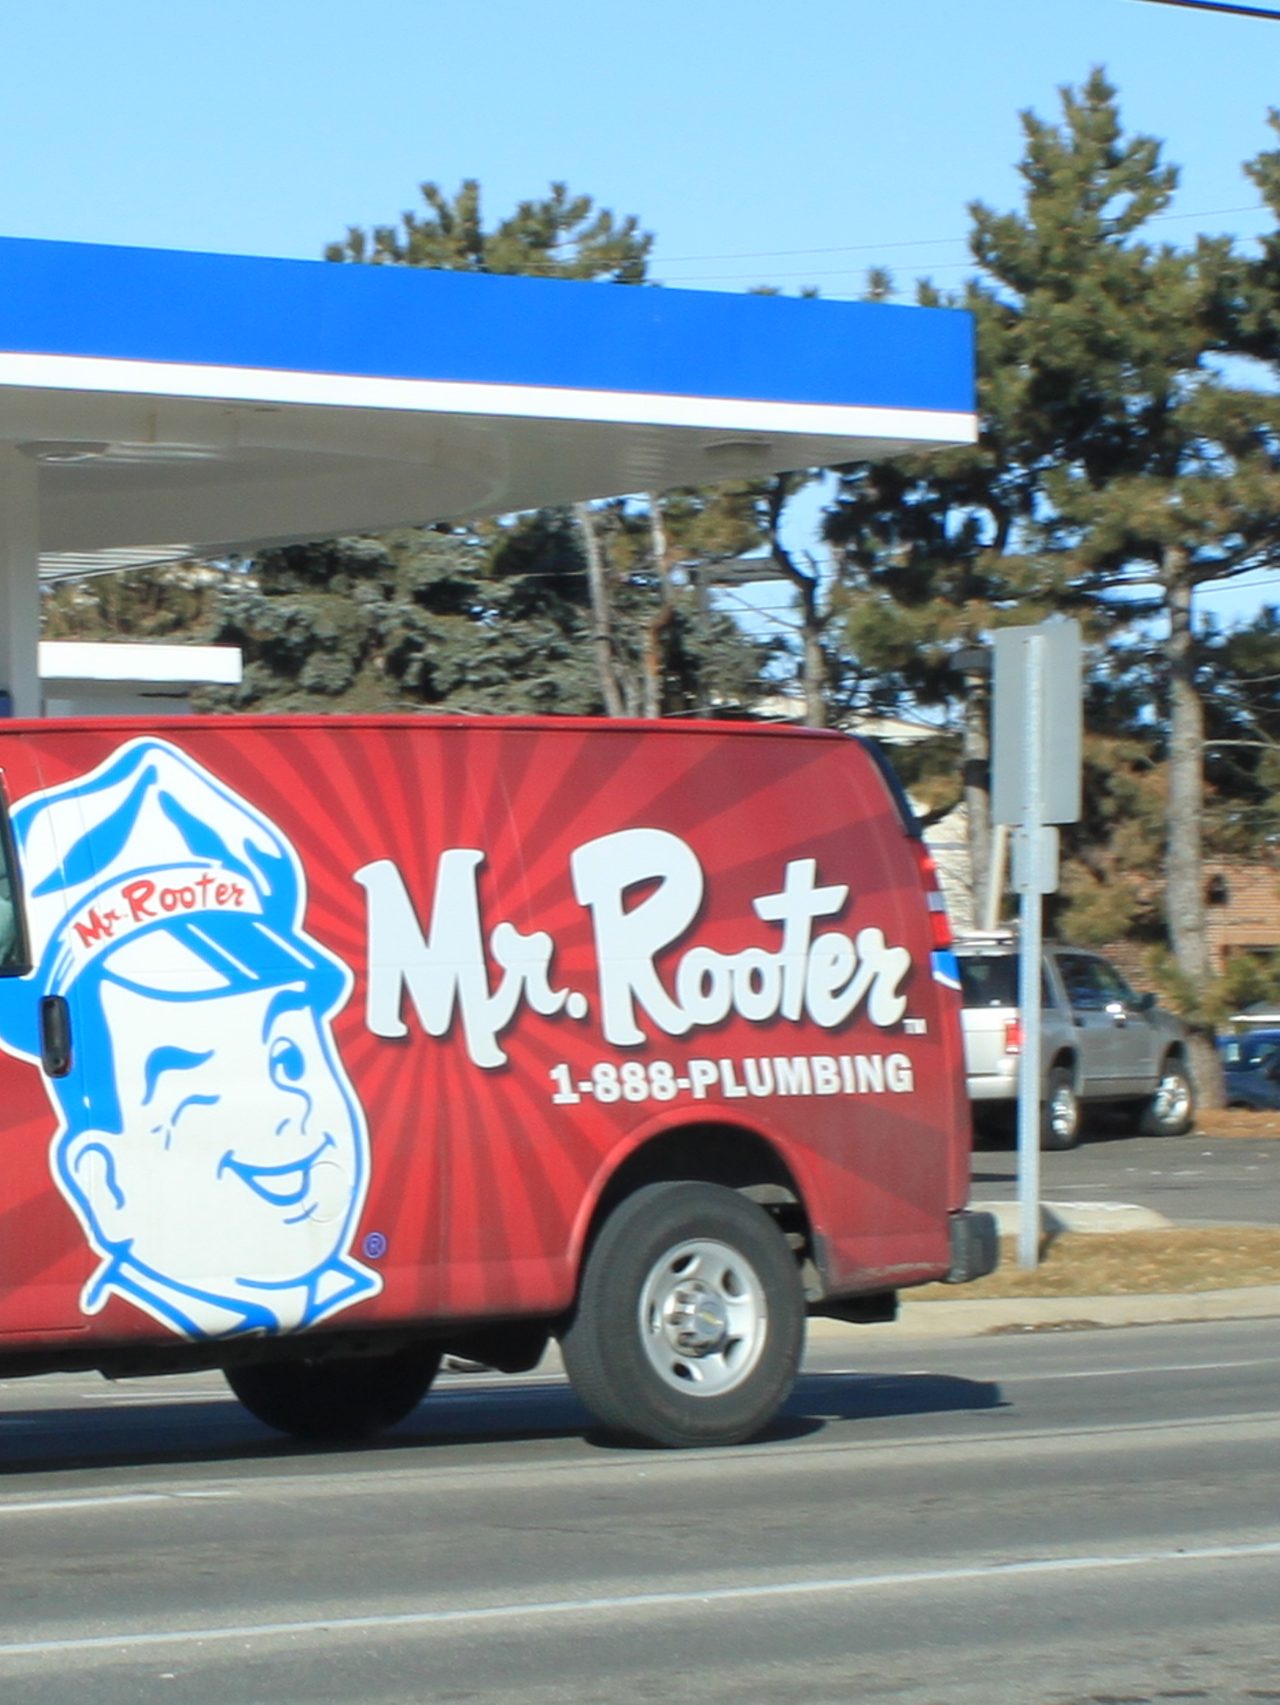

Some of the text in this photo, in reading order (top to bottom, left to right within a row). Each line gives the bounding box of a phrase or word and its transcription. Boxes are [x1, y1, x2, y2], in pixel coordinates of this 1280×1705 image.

[73, 872, 246, 949] Mr. Rooter
[353, 847, 588, 1068] Mr.
[570, 827, 912, 1046] Rooter
[550, 1053, 914, 1105] 1-888-PLUMBING
